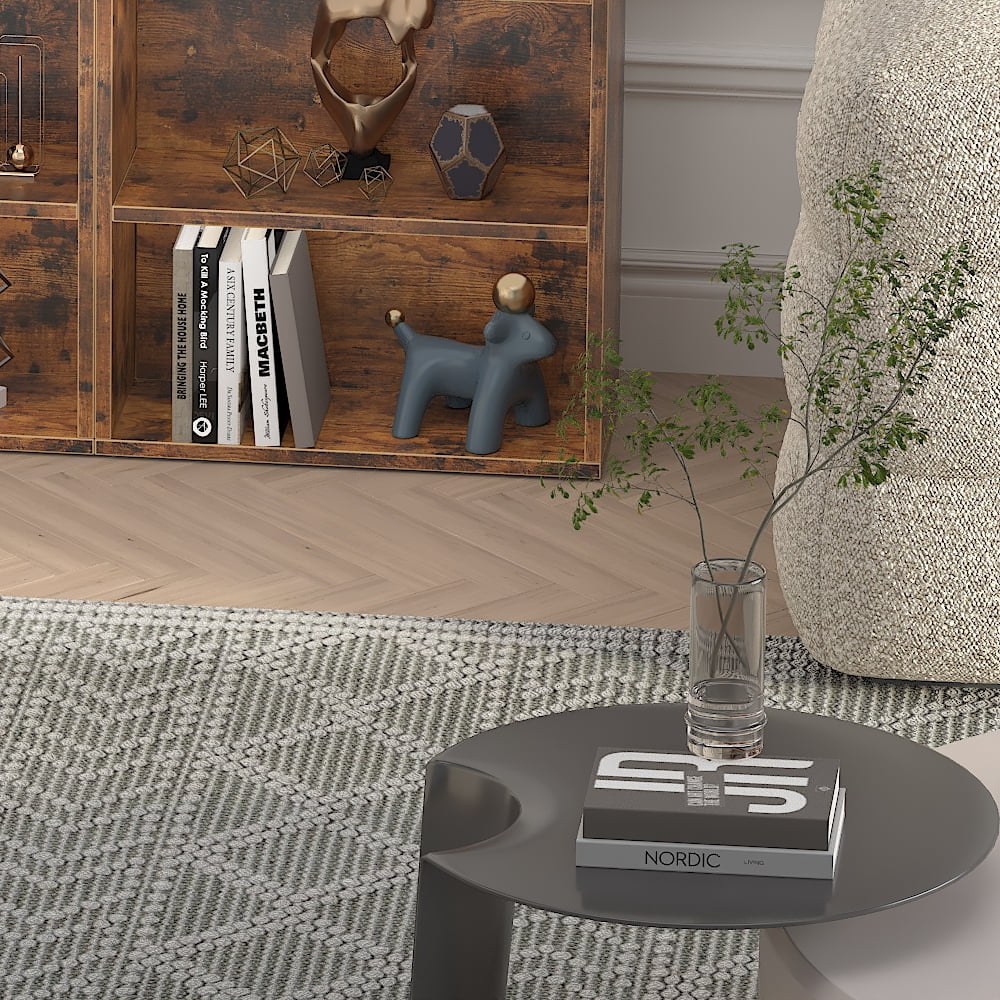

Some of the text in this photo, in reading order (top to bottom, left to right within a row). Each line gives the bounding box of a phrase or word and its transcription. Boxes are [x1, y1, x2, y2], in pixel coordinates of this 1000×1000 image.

[200, 253, 208, 264] To
[200, 266, 208, 278] Kill
[227, 275, 235, 290] SIX
[198, 290, 208, 329] Mocking
[226, 292, 235, 336] CENTURY
[200, 332, 208, 349] Bird
[254, 288, 271, 377] MACBETH
[177, 292, 187, 400] BRINGING THE HOUSE HOME
[226, 338, 235, 373] FAMILY
[198, 361, 208, 392] Harper
[199, 393, 207, 408] LEE
[644, 850, 721, 868] NORDIC
